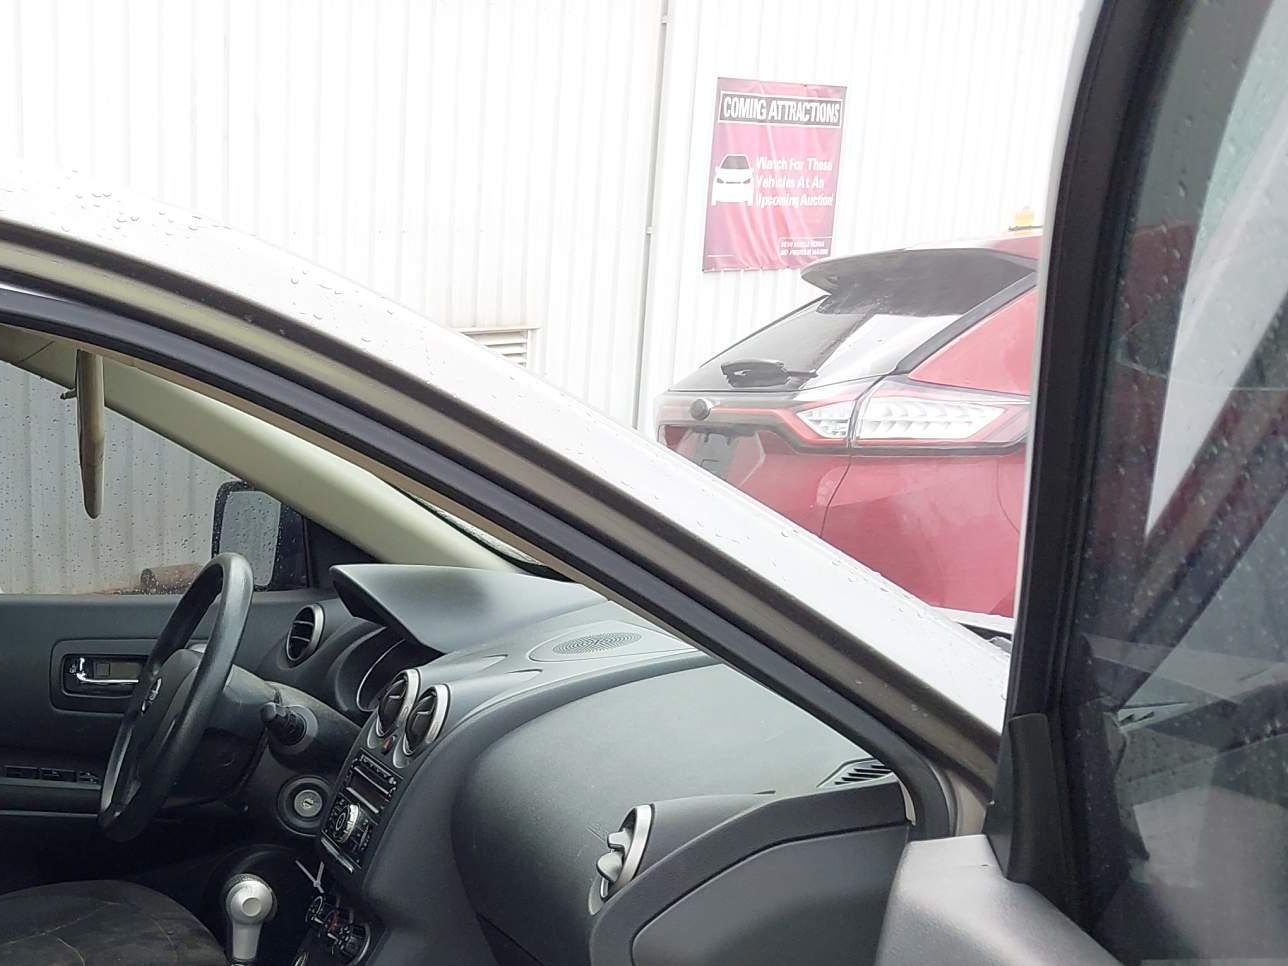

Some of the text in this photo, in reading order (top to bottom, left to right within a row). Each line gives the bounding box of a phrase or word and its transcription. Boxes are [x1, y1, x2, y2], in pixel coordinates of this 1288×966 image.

[723, 96, 841, 123] COMING ATTRACTIONS
[756, 156, 788, 170] Watch
[789, 158, 805, 170] For
[756, 175, 825, 188] Vehicles At An
[756, 192, 800, 208] Upcoming
